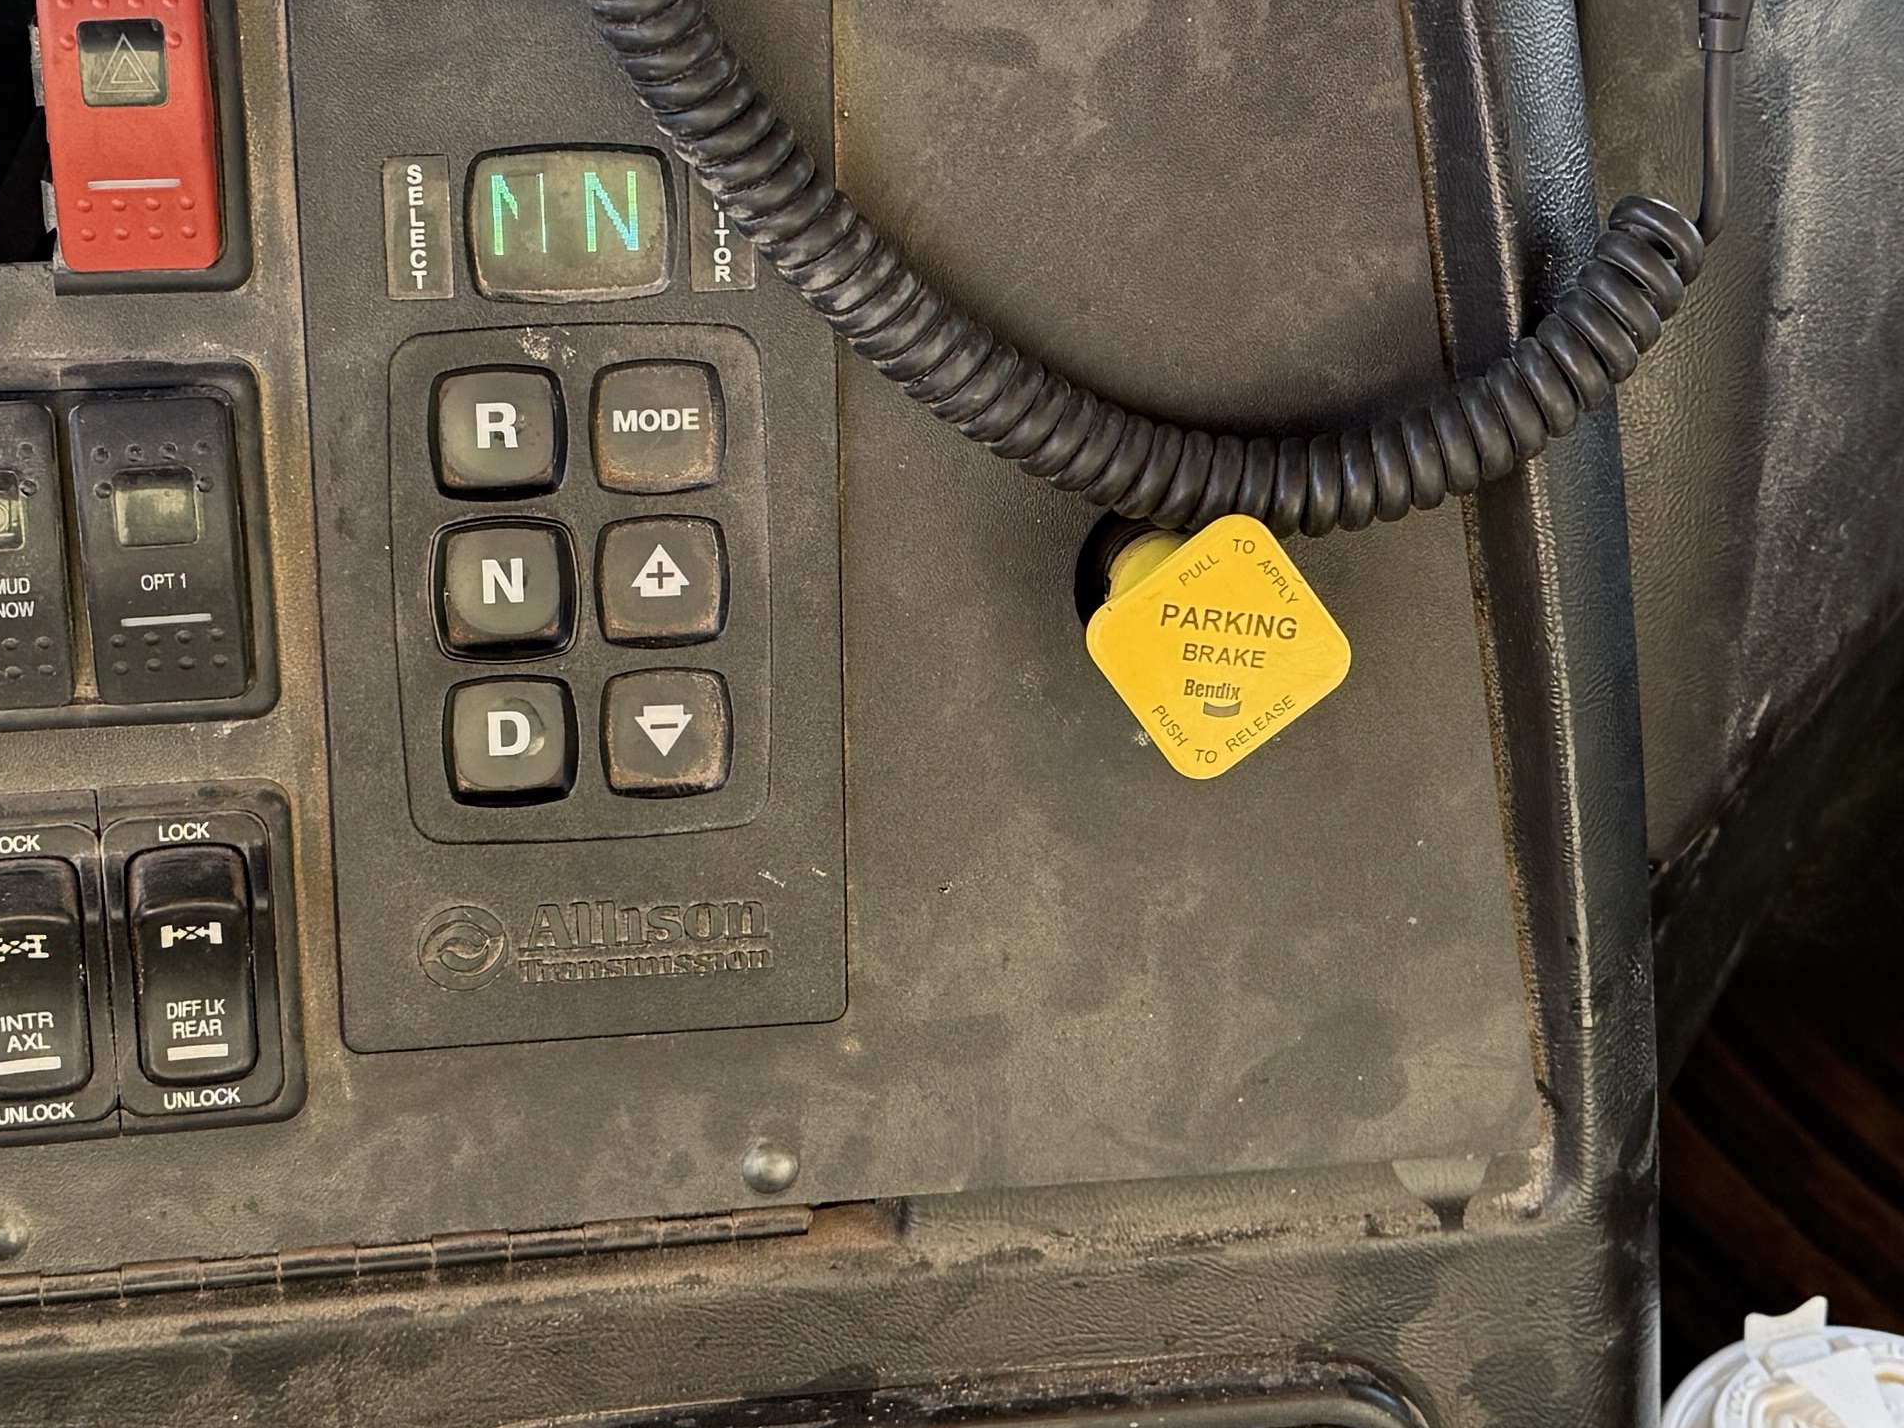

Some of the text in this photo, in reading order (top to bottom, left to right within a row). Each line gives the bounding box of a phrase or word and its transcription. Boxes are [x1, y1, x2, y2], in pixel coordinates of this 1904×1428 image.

[583, 170, 640, 253] N
[405, 163, 428, 290] SELECT
[475, 401, 519, 449] R
[612, 407, 700, 434] MODE
[140, 572, 188, 593] OPT 1
[481, 557, 525, 604] N
[1178, 538, 1300, 605] PULL TO APPLY
[1159, 603, 1298, 641] PARKING
[1182, 642, 1267, 669] BRAKE
[1183, 678, 1241, 701] Bendix
[486, 710, 531, 757] D
[1151, 695, 1295, 764] PUSH TO RELEASE
[158, 821, 210, 842] LOCK
[525, 898, 769, 950] Allison
[0, 1011, 54, 1033] INTR
[166, 998, 226, 1019] DIFF LK
[172, 1019, 223, 1039] REAR
[6, 1032, 51, 1054] AXL
[163, 1087, 241, 1110] UNLOCK
